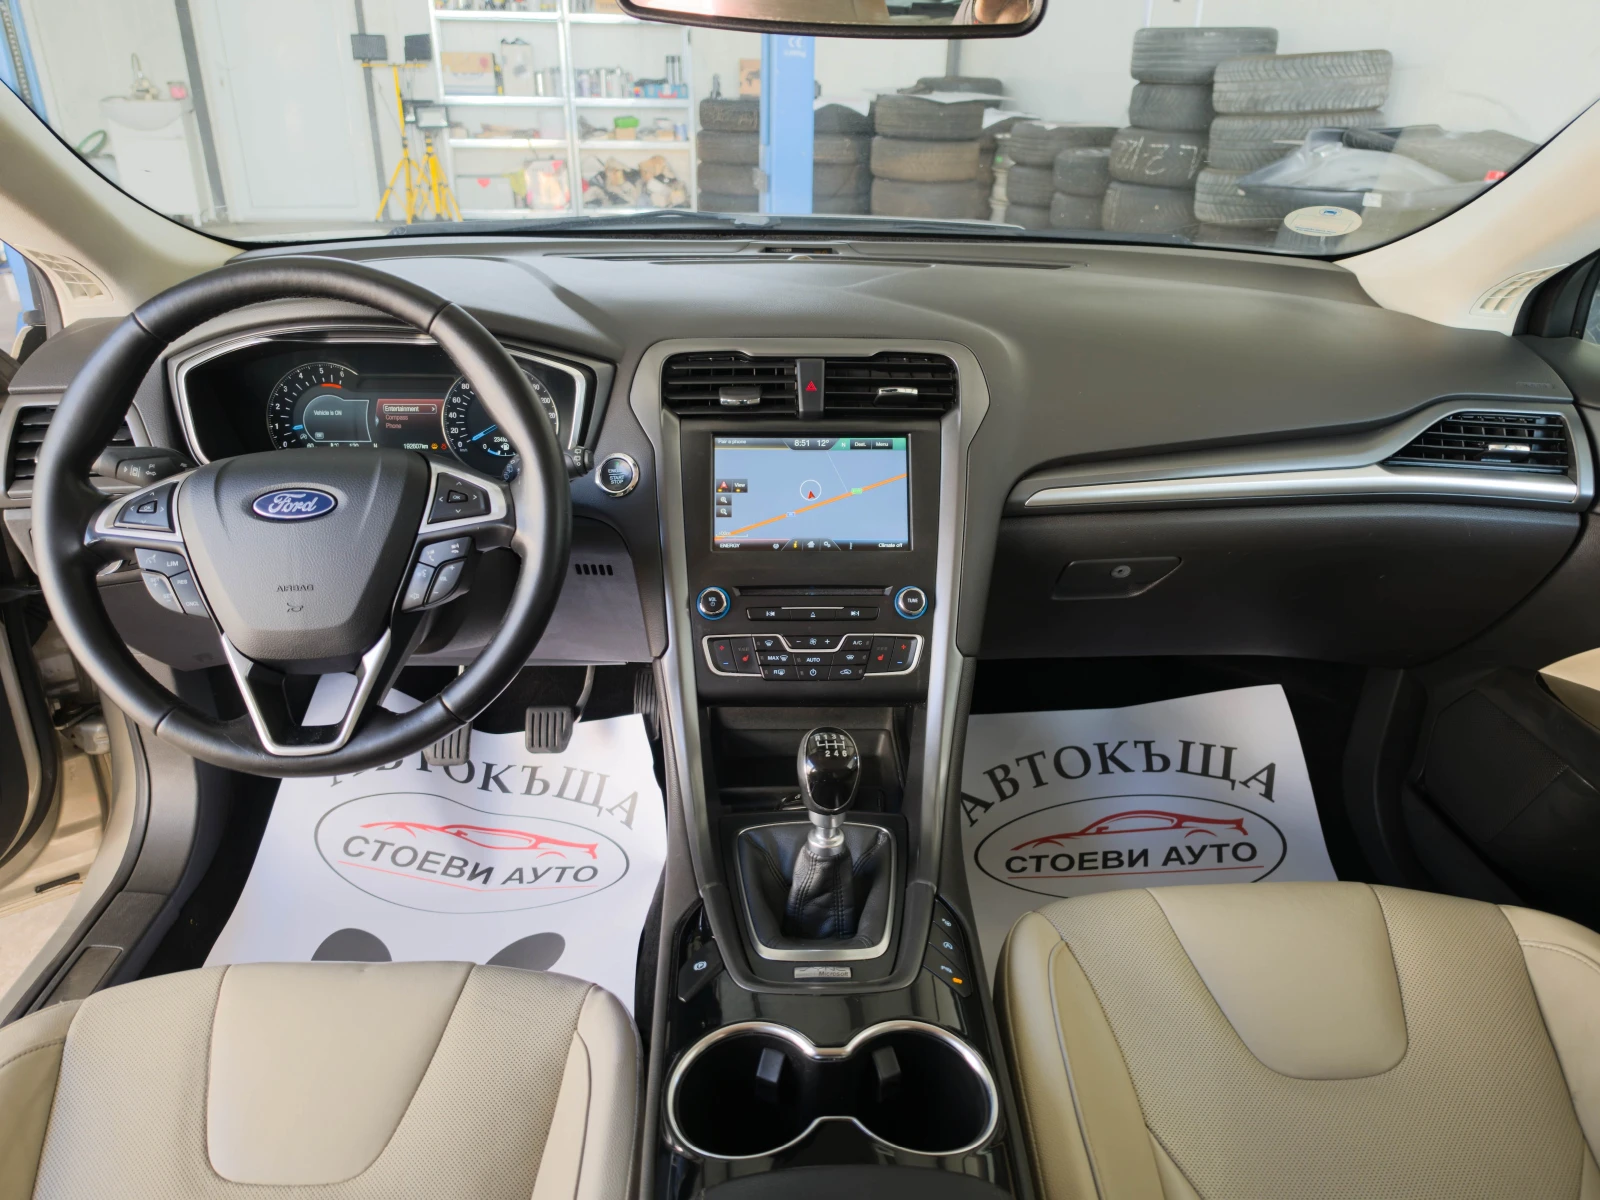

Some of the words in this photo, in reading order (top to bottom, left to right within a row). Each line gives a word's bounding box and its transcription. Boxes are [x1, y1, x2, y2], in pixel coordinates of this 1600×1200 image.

[452, 396, 461, 404] 60
[448, 411, 457, 419] 40
[794, 439, 810, 447] 8:51
[268, 493, 319, 513] Ford
[959, 739, 1277, 827] АВТОКЪЩА
[342, 835, 495, 886] СТОЕВИ
[501, 865, 600, 886] АУТО
[1005, 848, 1149, 874] СТОЕВИ
[1162, 842, 1258, 867] АУТО
